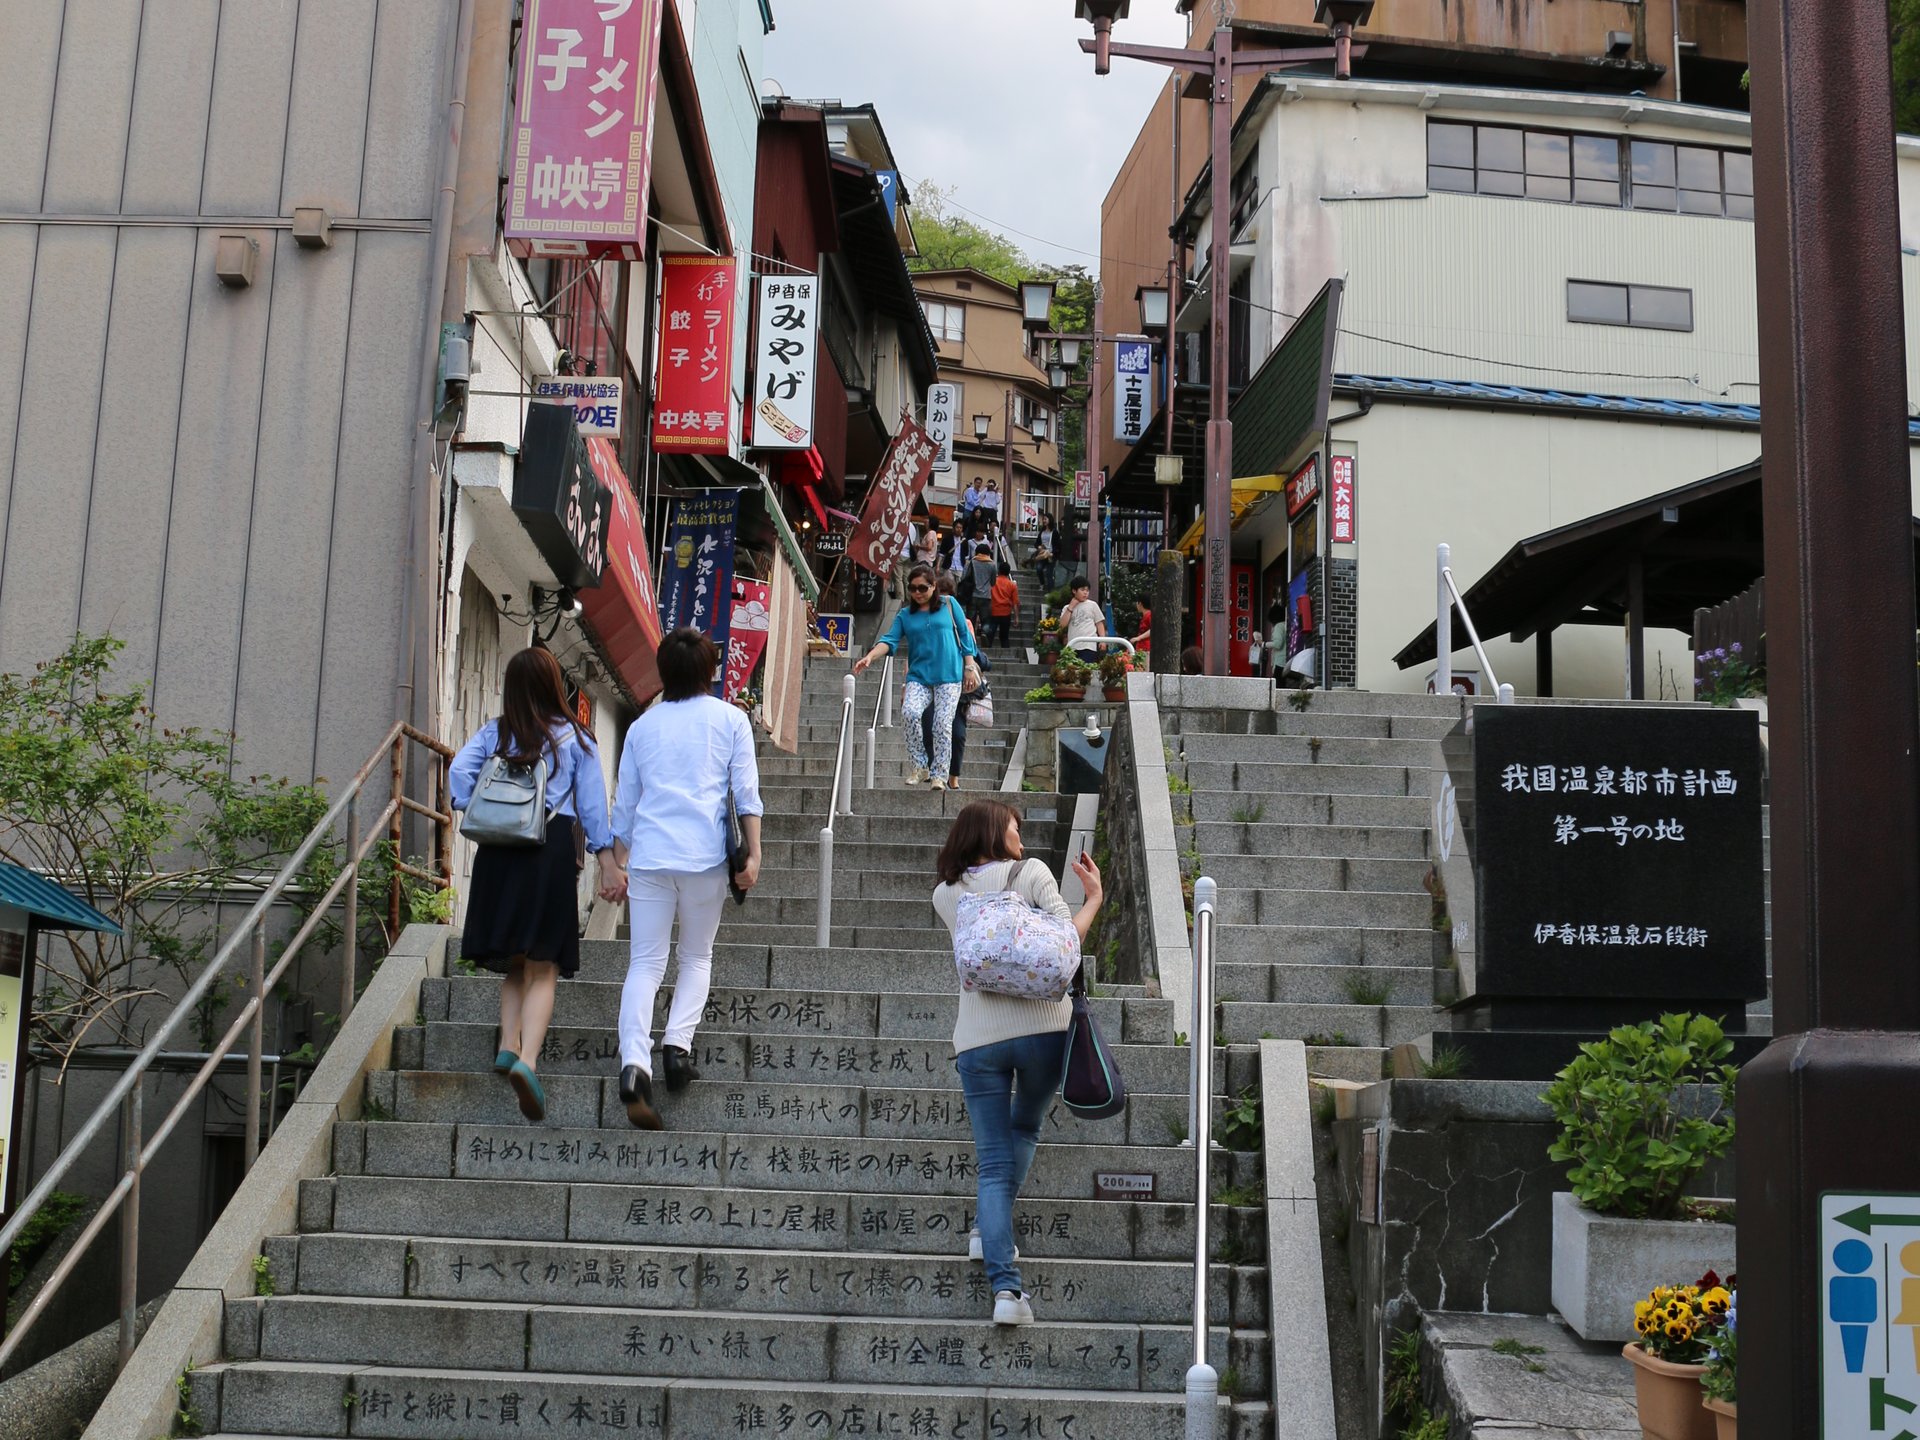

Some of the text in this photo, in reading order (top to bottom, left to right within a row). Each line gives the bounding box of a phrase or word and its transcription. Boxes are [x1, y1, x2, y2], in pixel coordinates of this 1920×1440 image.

[537, 28, 587, 92] 子
[531, 155, 623, 210] 中央亭
[767, 283, 811, 299] 伊香保
[669, 309, 691, 368] 餃子
[697, 271, 729, 383] 手打 ラーメン
[767, 303, 806, 401] みやげ
[538, 382, 619, 399] 伊香保観光協会
[1123, 374, 1142, 436] 十一屋酒店
[659, 408, 725, 431] 中央亭
[1500, 763, 1738, 797] 我国温泉都市計画
[1552, 814, 1685, 846] 第一号の地
[1534, 923, 1708, 948] 伊香保温泉石段街
[622, 1325, 782, 1361] 柔かい緑で
